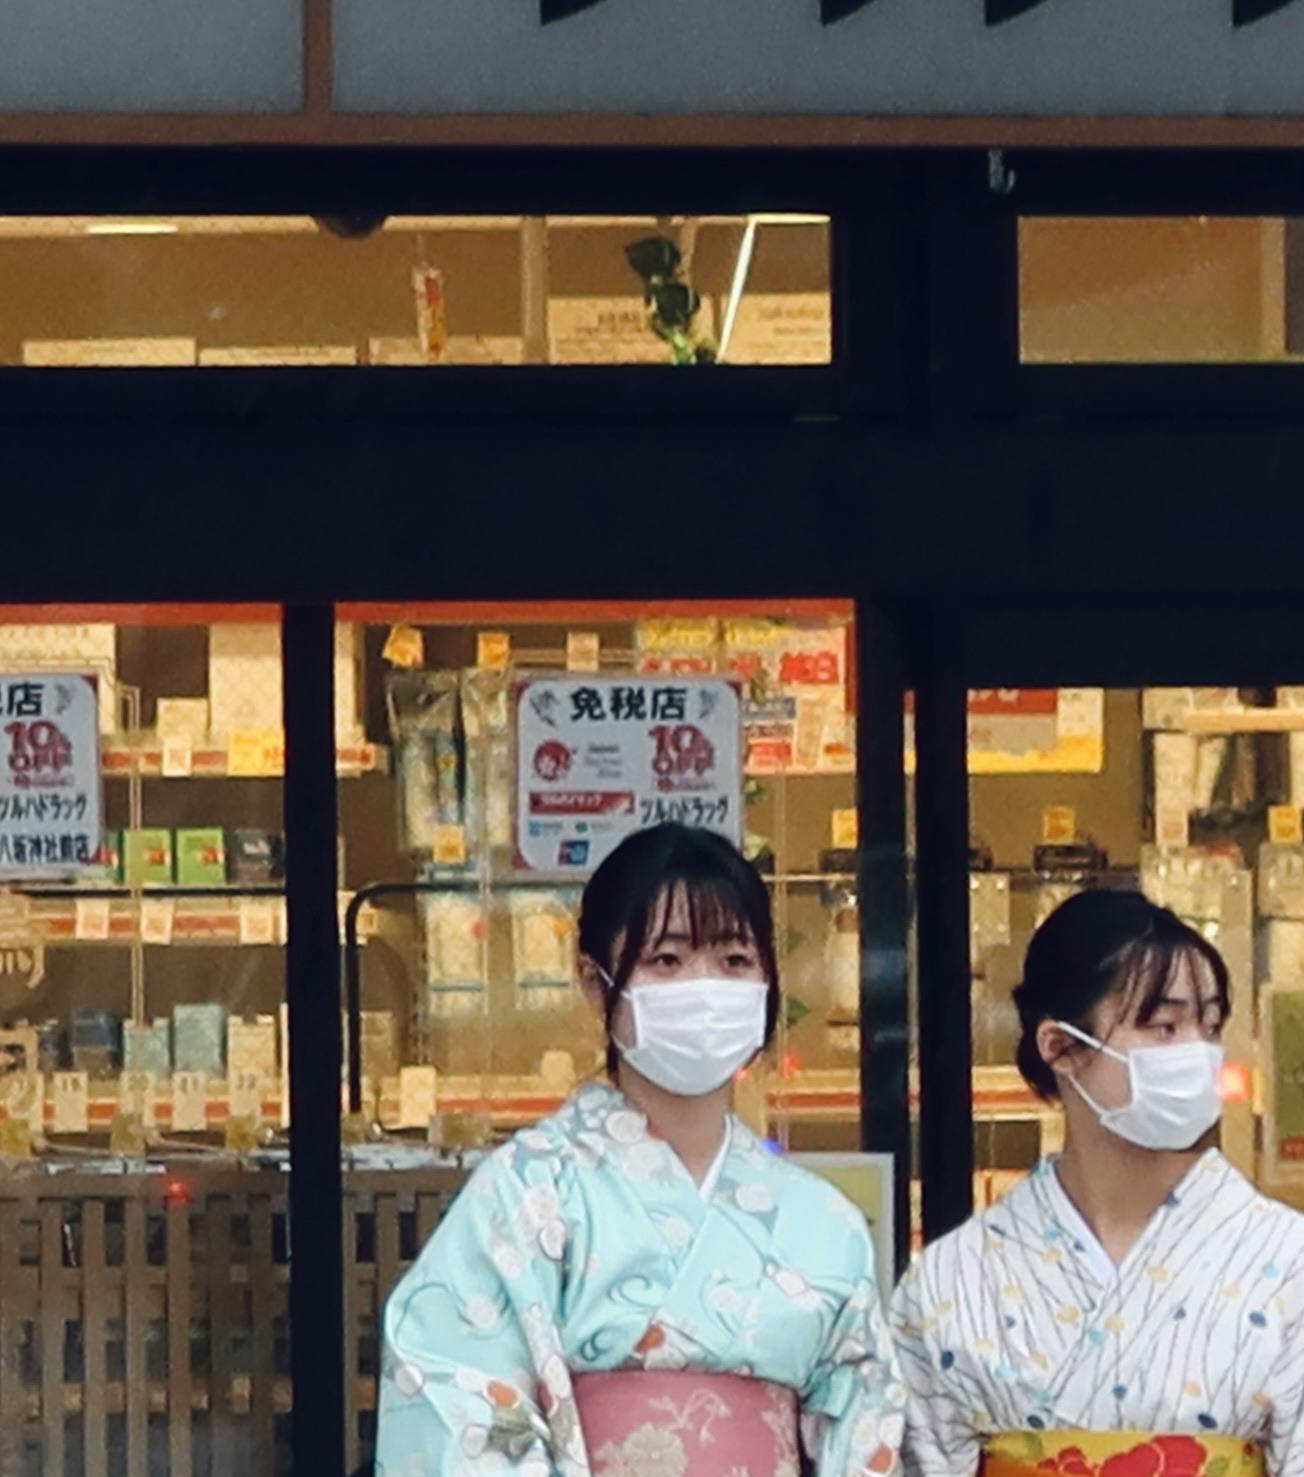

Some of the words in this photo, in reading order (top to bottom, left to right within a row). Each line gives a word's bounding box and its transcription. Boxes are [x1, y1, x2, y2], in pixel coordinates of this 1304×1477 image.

[0, 682, 44, 717] 店
[570, 686, 687, 721] 免税店
